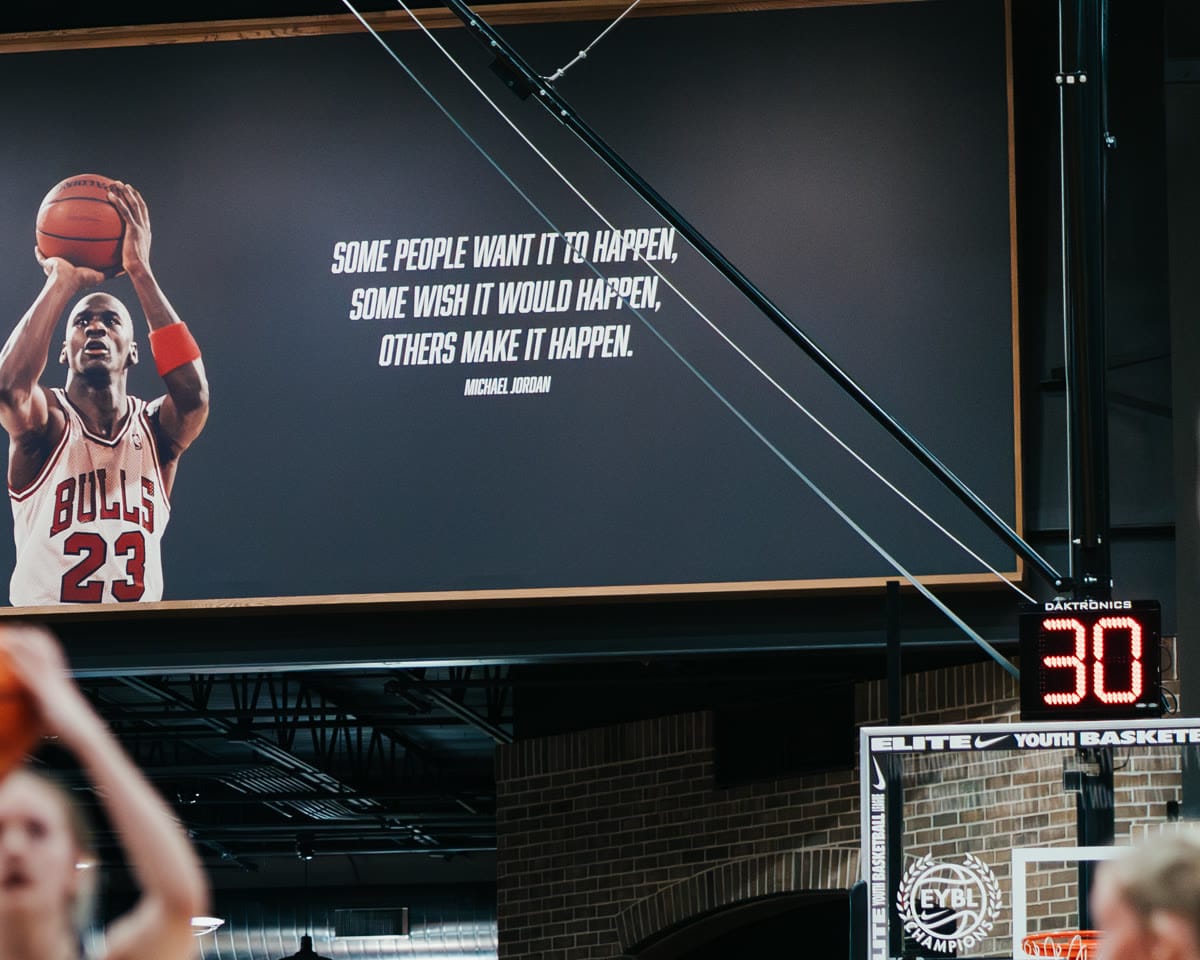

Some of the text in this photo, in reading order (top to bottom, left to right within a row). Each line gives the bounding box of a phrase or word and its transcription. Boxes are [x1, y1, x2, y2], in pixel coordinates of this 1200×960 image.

[331, 227, 678, 274] SOME PEOPLE WANT IT TO HAPPEN,
[350, 275, 661, 320] SOME WISH IT WOULD HAPPEN,
[378, 324, 633, 367] OTHERS MAKE IT HAPPEN.
[464, 376, 551, 396] MICHAEL JORDAN
[49, 469, 154, 538] BULLS
[60, 530, 146, 603] 23
[1045, 600, 1133, 611] DAKTRONICS
[1043, 617, 1142, 705] 30
[871, 735, 972, 751] ELITE
[1014, 731, 1075, 749] YOUTH
[872, 813, 886, 881] BASKETBALL
[920, 888, 979, 909] EYBL
[904, 920, 994, 953] CHAMPIONS
